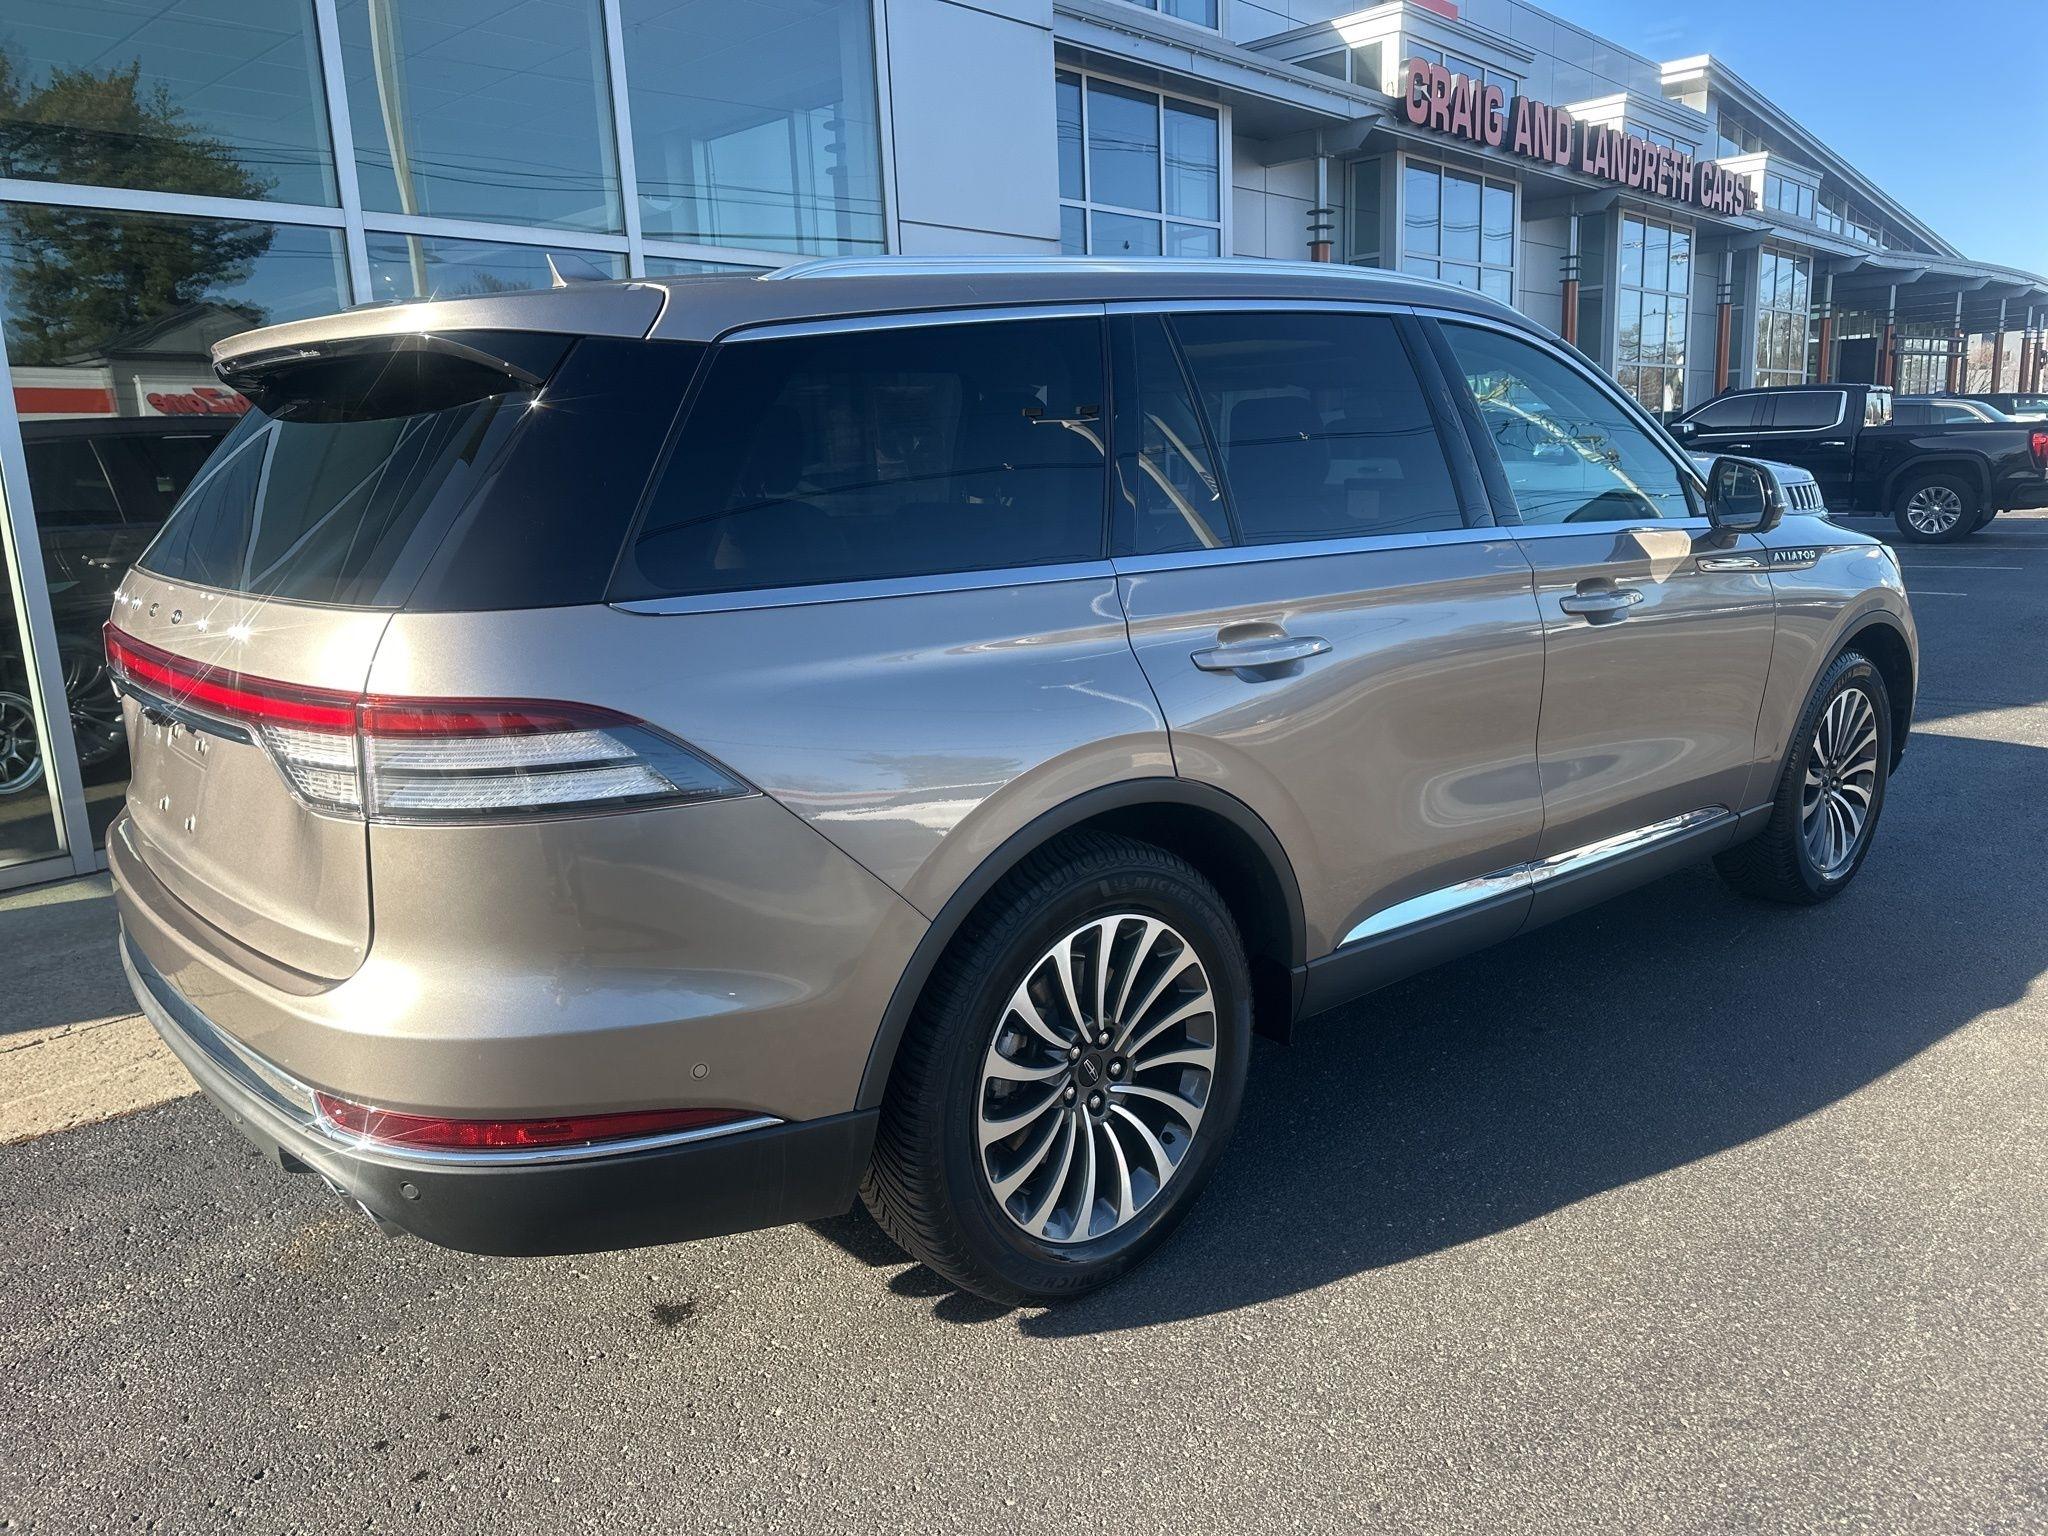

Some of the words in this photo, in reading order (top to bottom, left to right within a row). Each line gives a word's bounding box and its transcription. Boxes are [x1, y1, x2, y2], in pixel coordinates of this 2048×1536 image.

[1404, 56, 1504, 147] CRAIG
[1513, 95, 1572, 166] AND
[1582, 119, 1693, 202] LANDRETH
[1700, 161, 1745, 216] CARS
[1773, 550, 1816, 561] AVIATOR
